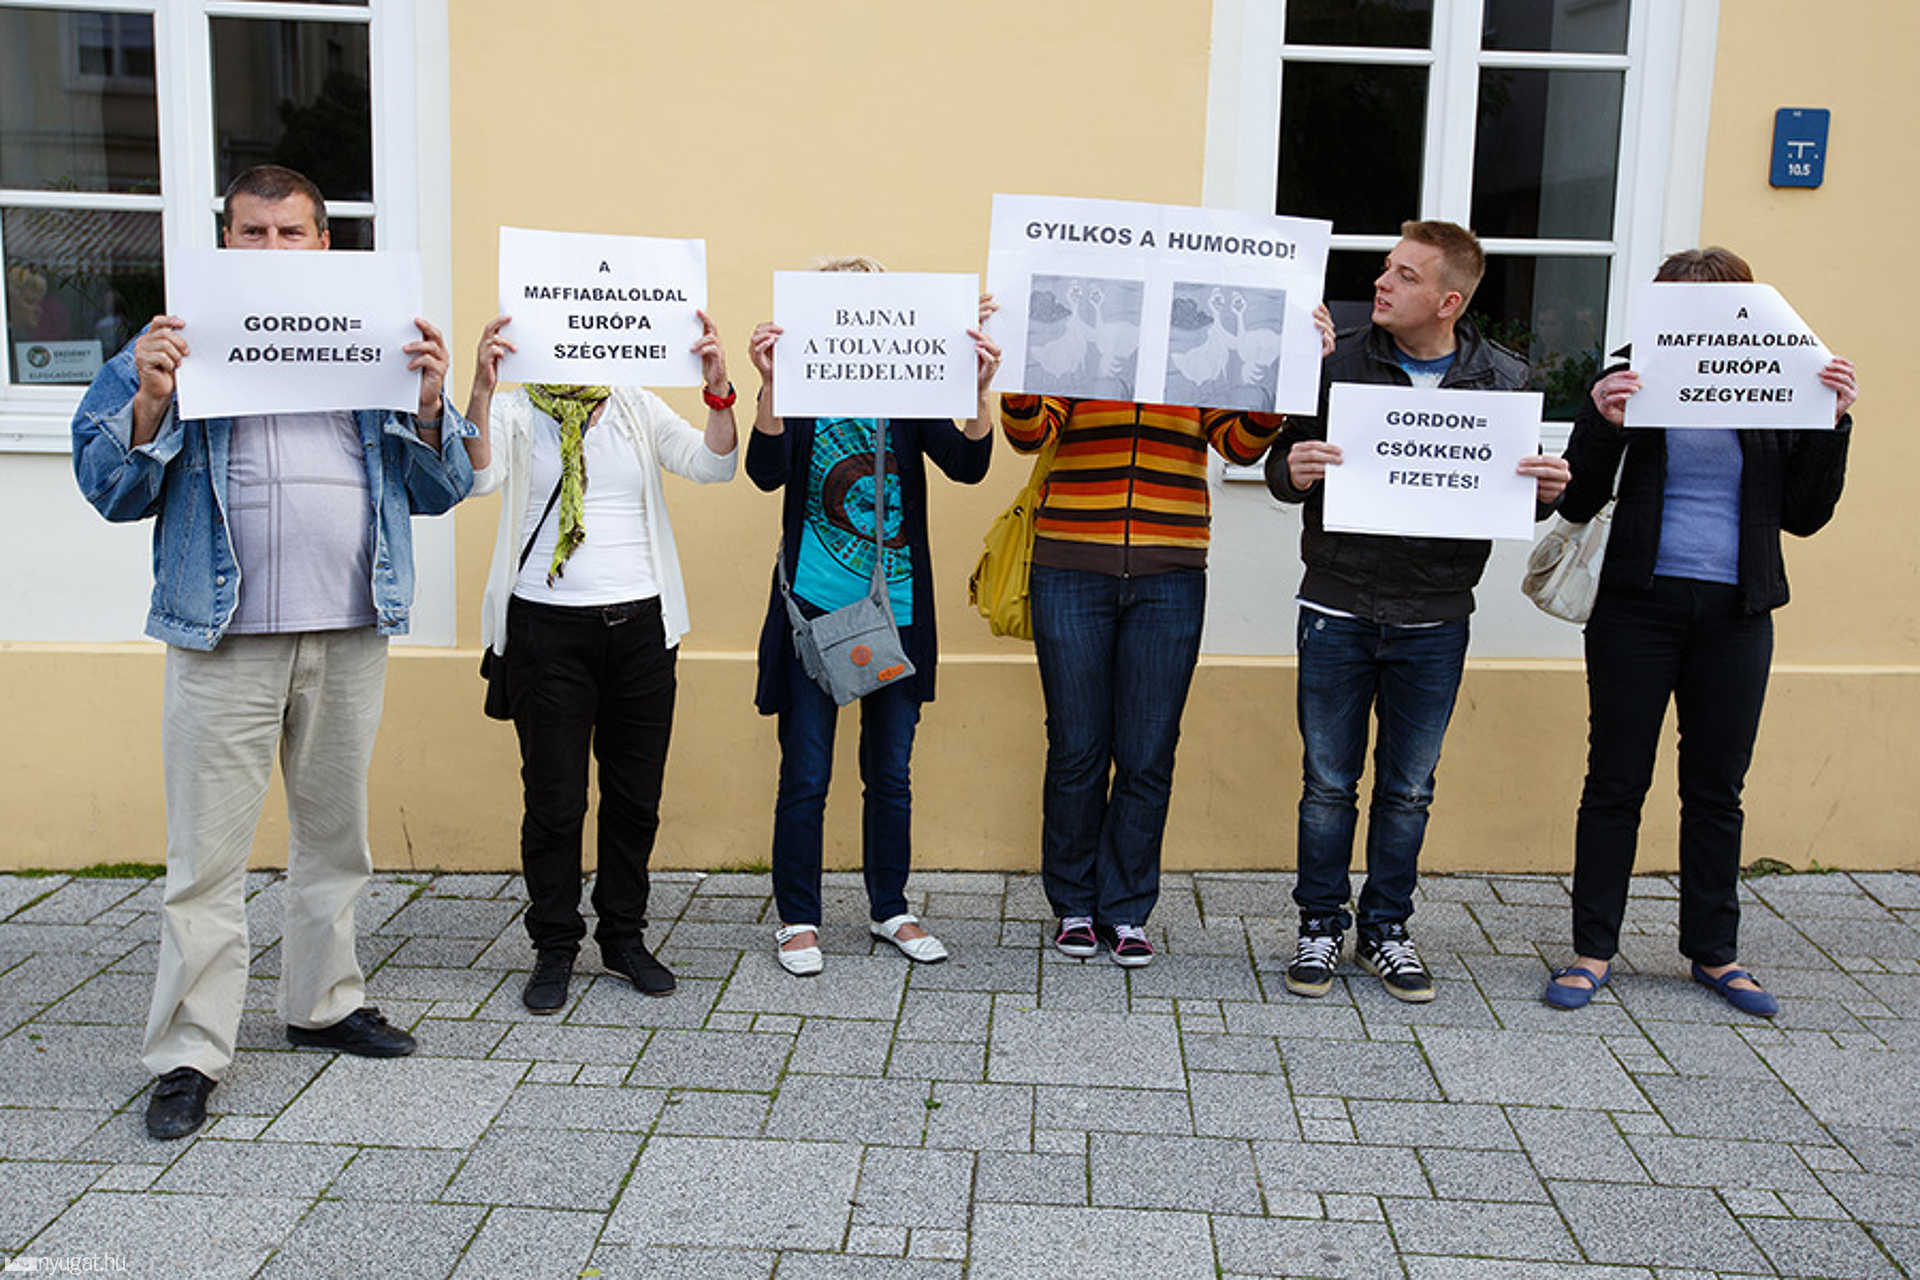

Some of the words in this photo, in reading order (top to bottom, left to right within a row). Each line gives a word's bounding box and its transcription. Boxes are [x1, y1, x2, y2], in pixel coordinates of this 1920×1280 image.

[1026, 221, 1132, 246] GYILKOS
[1140, 230, 1156, 247] A
[1168, 231, 1296, 260] HUMOROD!
[599, 260, 611, 273] A
[524, 285, 688, 302] MAFFIABALOLDAL
[568, 312, 652, 330] EURÓPA
[836, 309, 915, 327] BAJNAI
[1736, 306, 1749, 319] A
[244, 315, 362, 332] GORDON=
[804, 338, 819, 355] A
[825, 338, 947, 356] TOLVAJOK
[1657, 333, 1818, 347] MAFFIABALOLDAL
[228, 344, 382, 362] ADÓEMELÉS!
[554, 341, 667, 360] SZÉGYENE!
[806, 362, 945, 381] FEJEDELME!
[1697, 356, 1781, 375] EURÓPA
[1678, 385, 1794, 403] SZÉGYENE!
[1386, 411, 1488, 430] GORDON=
[1389, 470, 1480, 490] FIZETÉS!
